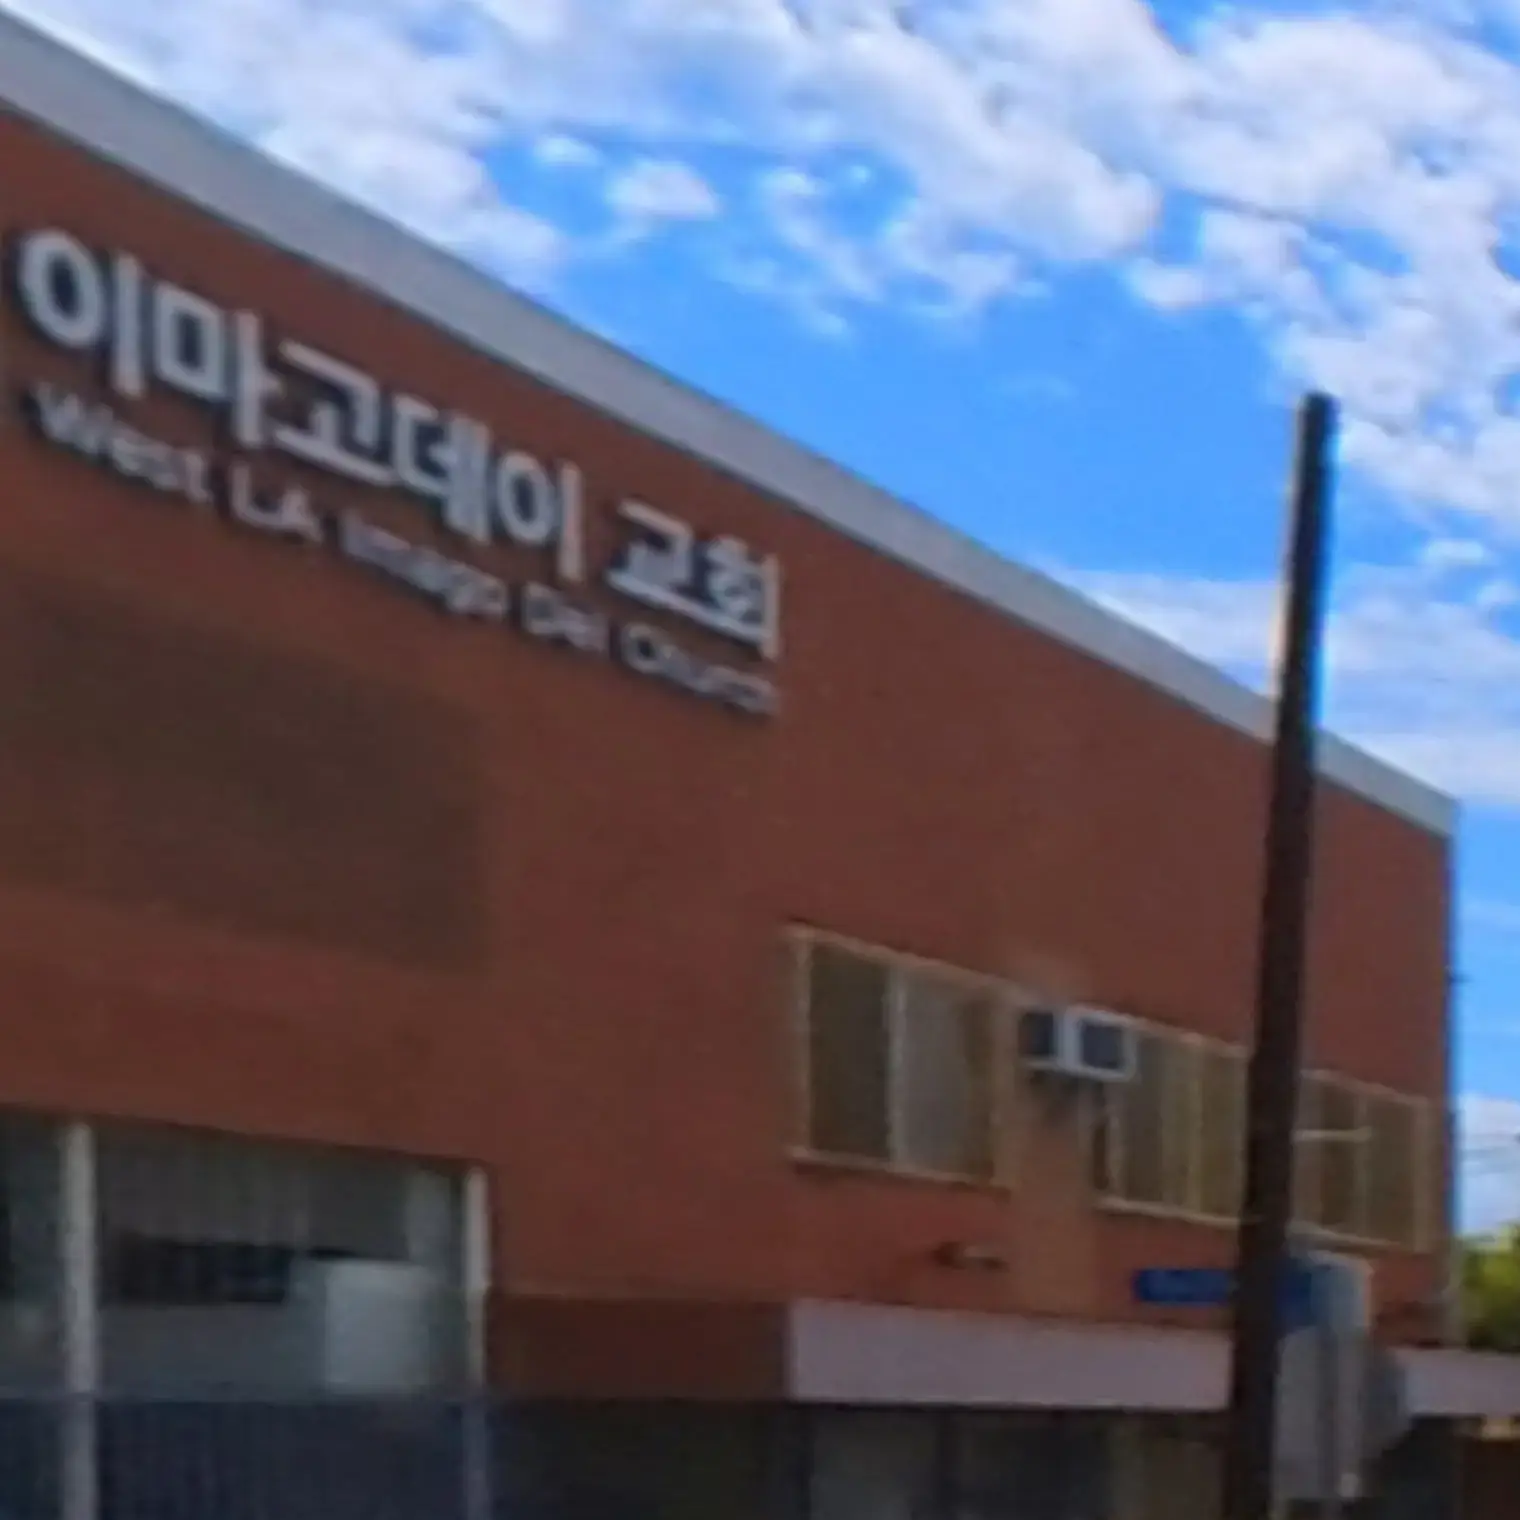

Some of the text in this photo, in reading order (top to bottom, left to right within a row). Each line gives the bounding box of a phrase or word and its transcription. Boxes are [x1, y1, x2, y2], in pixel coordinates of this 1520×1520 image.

[18, 229, 780, 659] 이마고데이 교회
[32, 382, 213, 504] West
[230, 461, 323, 542] LA
